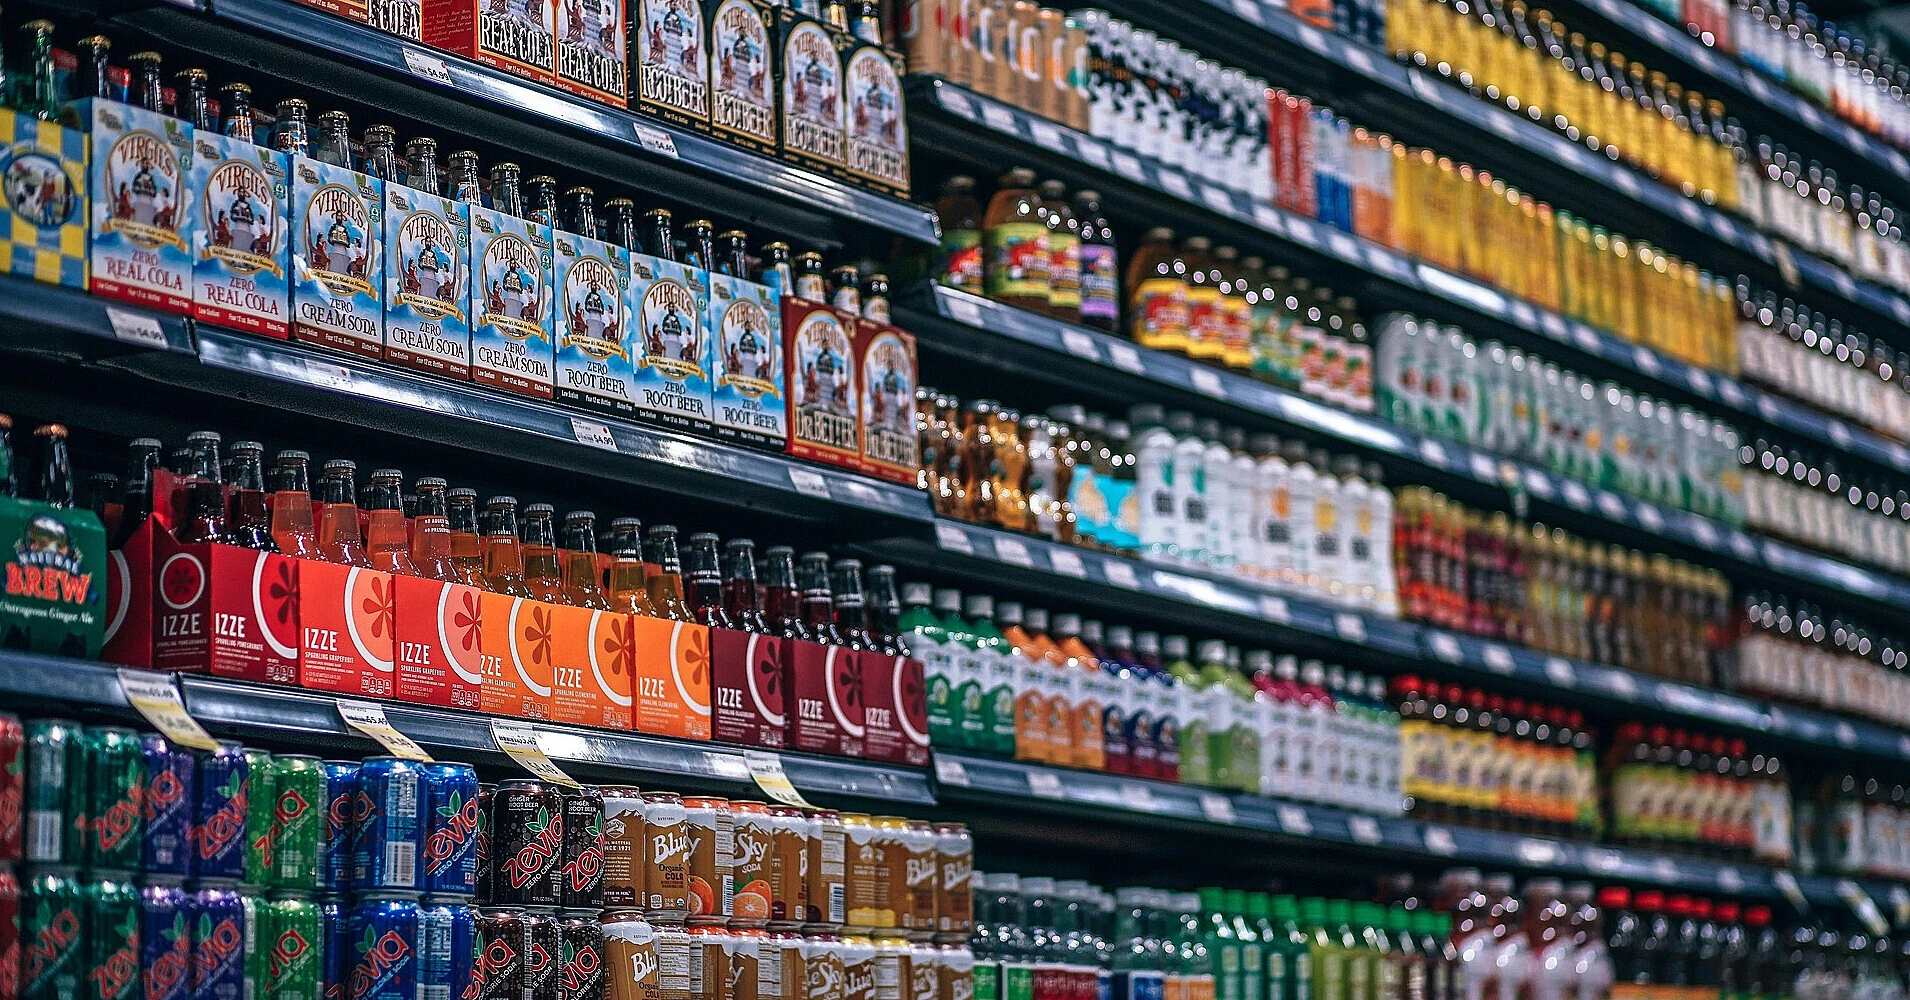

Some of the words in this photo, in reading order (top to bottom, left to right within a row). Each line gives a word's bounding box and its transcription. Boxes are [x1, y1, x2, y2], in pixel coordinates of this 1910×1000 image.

[480, 14, 516, 56] REAL
[518, 28, 554, 69] COLA
[559, 42, 592, 83] REAL
[594, 56, 624, 96] COLA
[119, 135, 174, 178] VIRGIL'S
[216, 165, 269, 206] VIRGIL'S
[316, 190, 366, 229] VIRGIL'S
[406, 216, 453, 256] VIRGIL'S
[132, 250, 159, 266] ZERO
[492, 238, 537, 276] VIRGIL'S
[104, 256, 145, 280] REAL
[148, 267, 183, 290] COLA
[230, 276, 255, 291] ZERO
[573, 261, 617, 297] VIRGIL'S
[204, 283, 242, 307] REAL
[245, 292, 279, 316] COLA
[330, 298, 353, 313] ZERO
[650, 283, 694, 319] VIRGIL'S
[302, 303, 347, 330] CREAM
[348, 316, 377, 337] SODA
[420, 321, 442, 336] ZERO
[392, 327, 435, 352] CREAM
[436, 339, 465, 360] SODA
[504, 341, 526, 356] ZERO
[478, 347, 520, 370] CREAM
[521, 357, 548, 378] SODA
[587, 361, 608, 374] ZERO
[565, 368, 597, 390] ROOT
[598, 375, 628, 398] BEER
[664, 382, 686, 394] ZERO
[643, 389, 674, 409] ROOT
[675, 395, 706, 417] BEER
[6, 561, 92, 605] BREW
[162, 613, 201, 637] IZZE
[215, 613, 246, 638] IZZE
[304, 627, 338, 652] IZZE
[401, 642, 431, 665] IZZE
[481, 654, 502, 676] ZZE
[554, 667, 583, 688] IZZE
[639, 677, 665, 698] IZZE
[718, 687, 743, 708] IZZE
[799, 698, 824, 720] IZZE
[434, 860, 452, 877] ZERO
[658, 864, 684, 873] Organic
[742, 862, 761, 873] SODA
[524, 873, 542, 889] ZERO
[584, 876, 598, 892] ZERO
[501, 962, 517, 982] SODA
[539, 966, 552, 984] SODA
